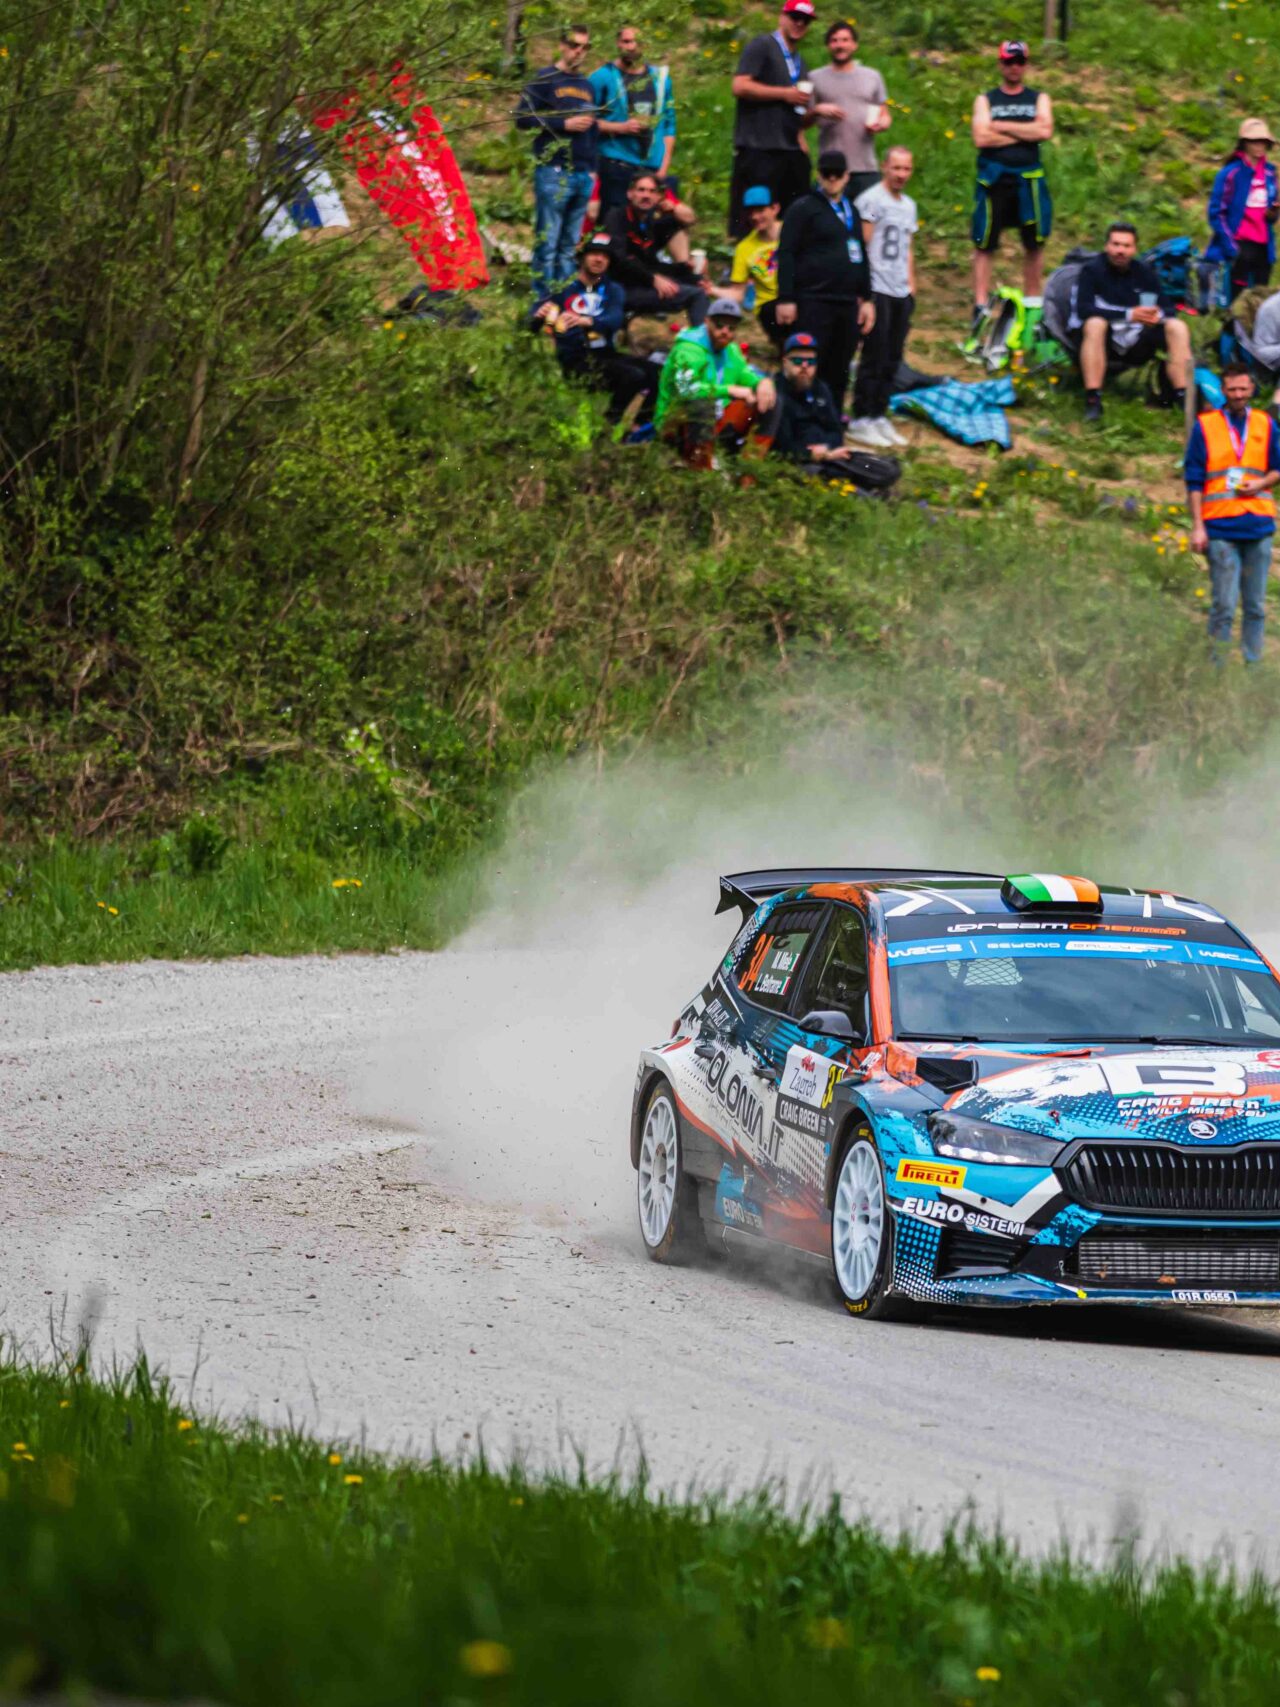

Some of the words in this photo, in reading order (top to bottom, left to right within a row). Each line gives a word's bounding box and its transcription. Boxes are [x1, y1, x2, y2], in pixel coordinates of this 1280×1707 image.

[882, 224, 900, 261] 8
[738, 932, 775, 993] 34
[790, 1067, 818, 1100] Zagreb
[780, 1100, 799, 1125] CRAIG
[798, 1107, 821, 1133] BREEN
[1117, 1097, 1184, 1109] CRAIG
[1119, 1109, 1142, 1117] WE
[1147, 1107, 1182, 1116] WILL
[1187, 1107, 1226, 1115] MISS
[1236, 1109, 1267, 1118] YOU
[902, 1163, 960, 1185] PIRELLI
[902, 1196, 965, 1223] EURO
[963, 1212, 1026, 1236] SISTEMI
[1178, 1292, 1202, 1302] 01R
[1203, 1292, 1232, 1302] 0555
